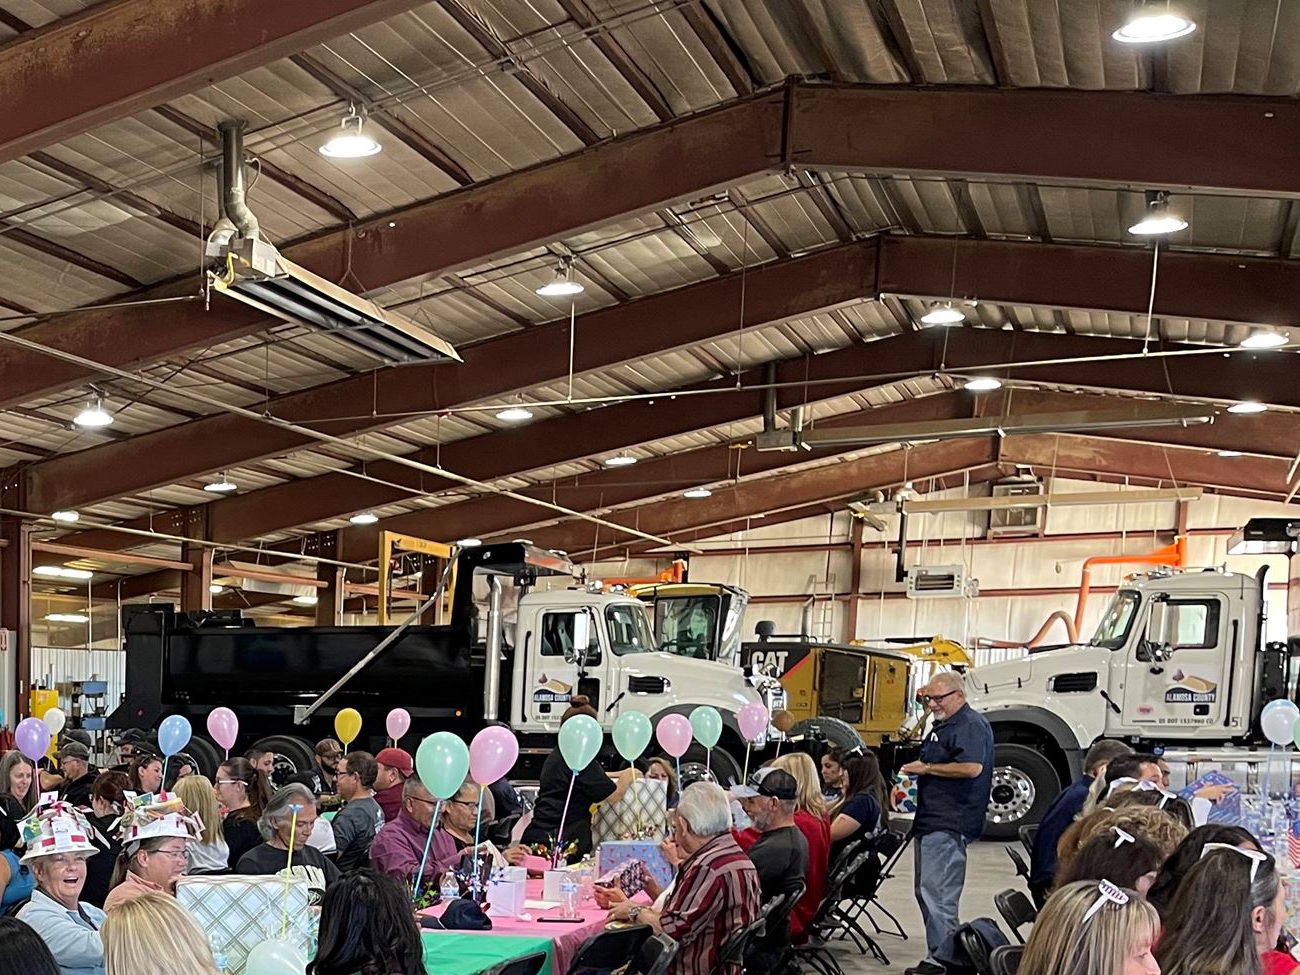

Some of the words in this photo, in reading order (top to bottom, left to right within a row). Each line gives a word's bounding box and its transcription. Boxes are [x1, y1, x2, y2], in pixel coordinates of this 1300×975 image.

[752, 651, 788, 675] CAT
[1166, 693, 1192, 702] ALAMOSA
[1193, 693, 1215, 702] COUNTY
